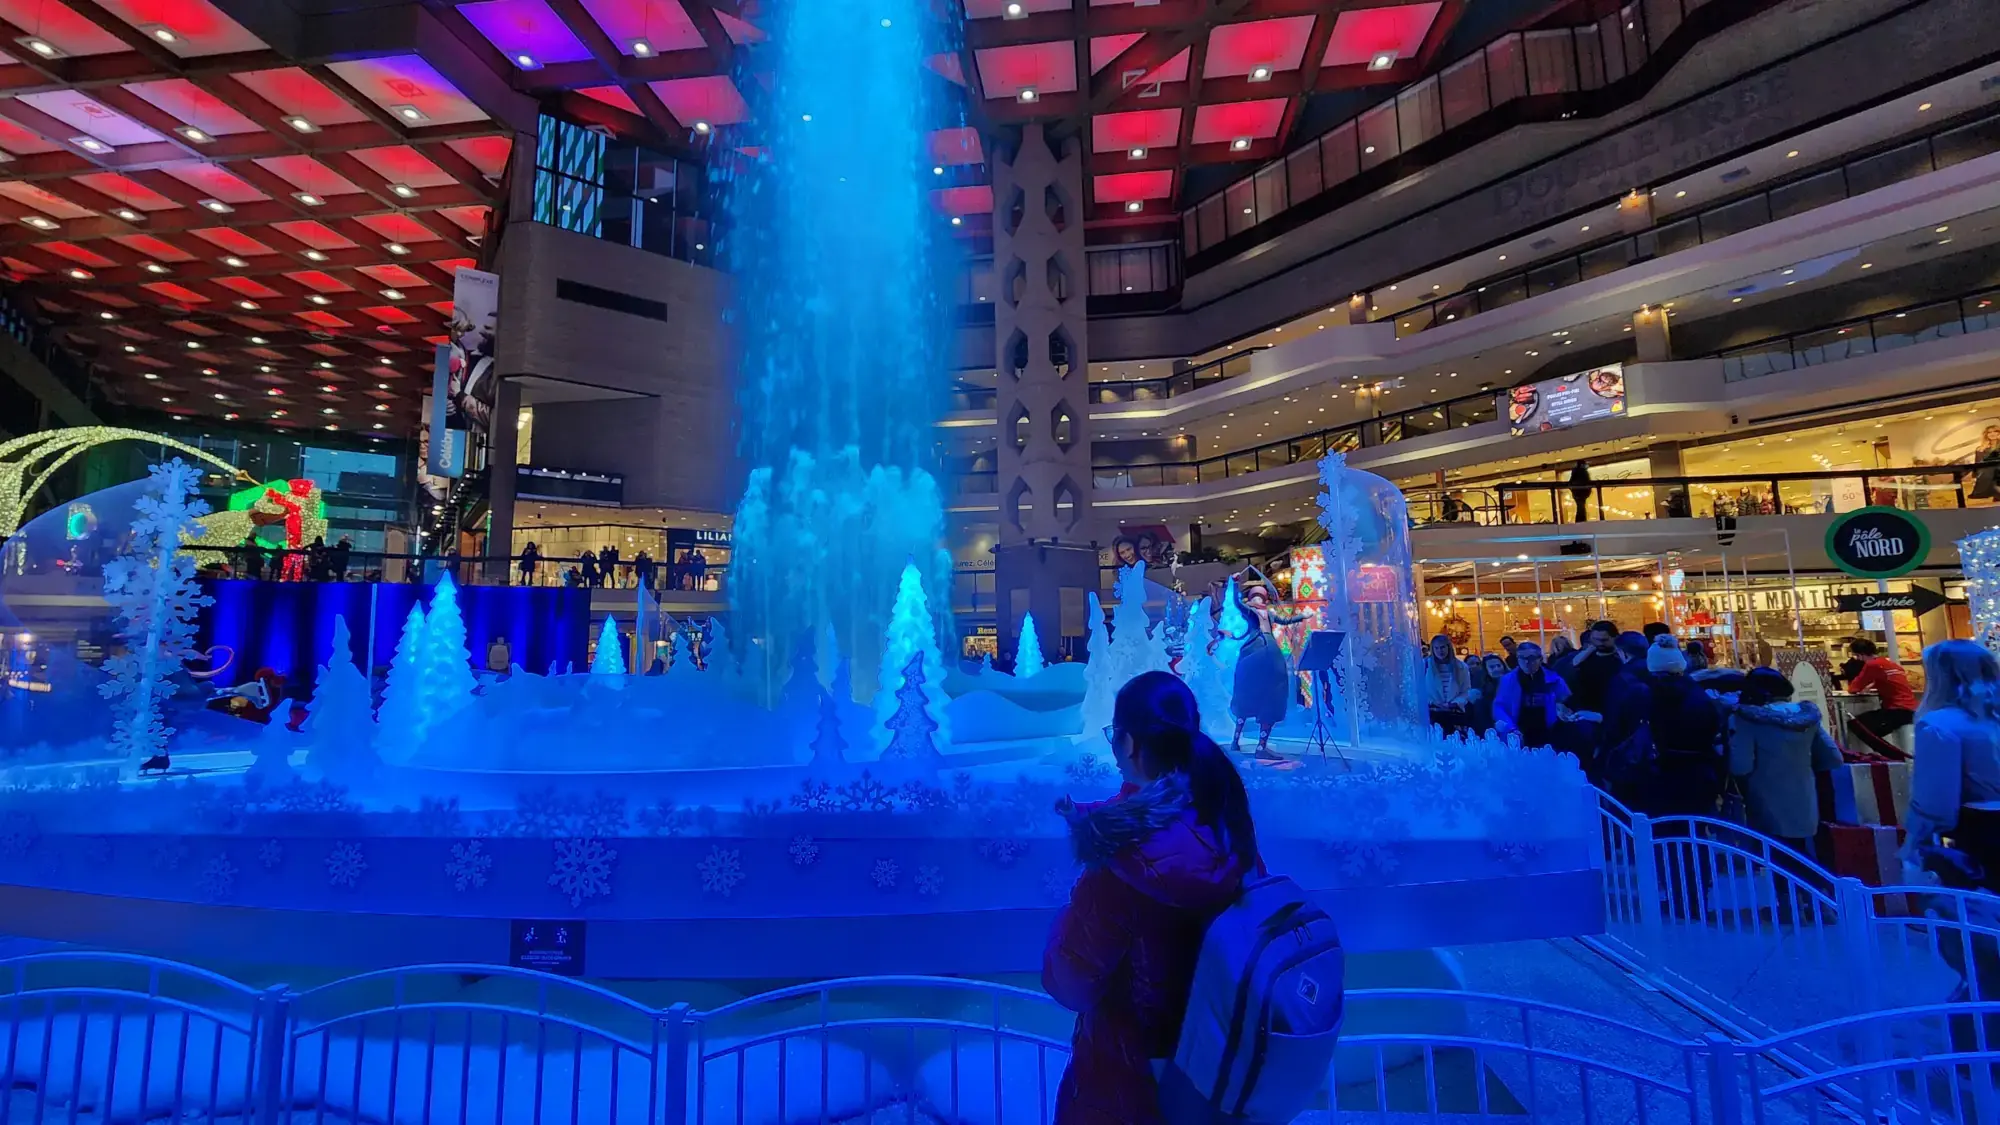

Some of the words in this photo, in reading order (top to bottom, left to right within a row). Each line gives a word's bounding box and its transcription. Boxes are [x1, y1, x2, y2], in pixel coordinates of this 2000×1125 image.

[439, 428, 453, 469] Célébr
[1849, 527, 1883, 547] pôle
[1855, 537, 1904, 558] NORD
[1736, 591, 1757, 610] DE
[1861, 595, 1916, 609] Entrée
